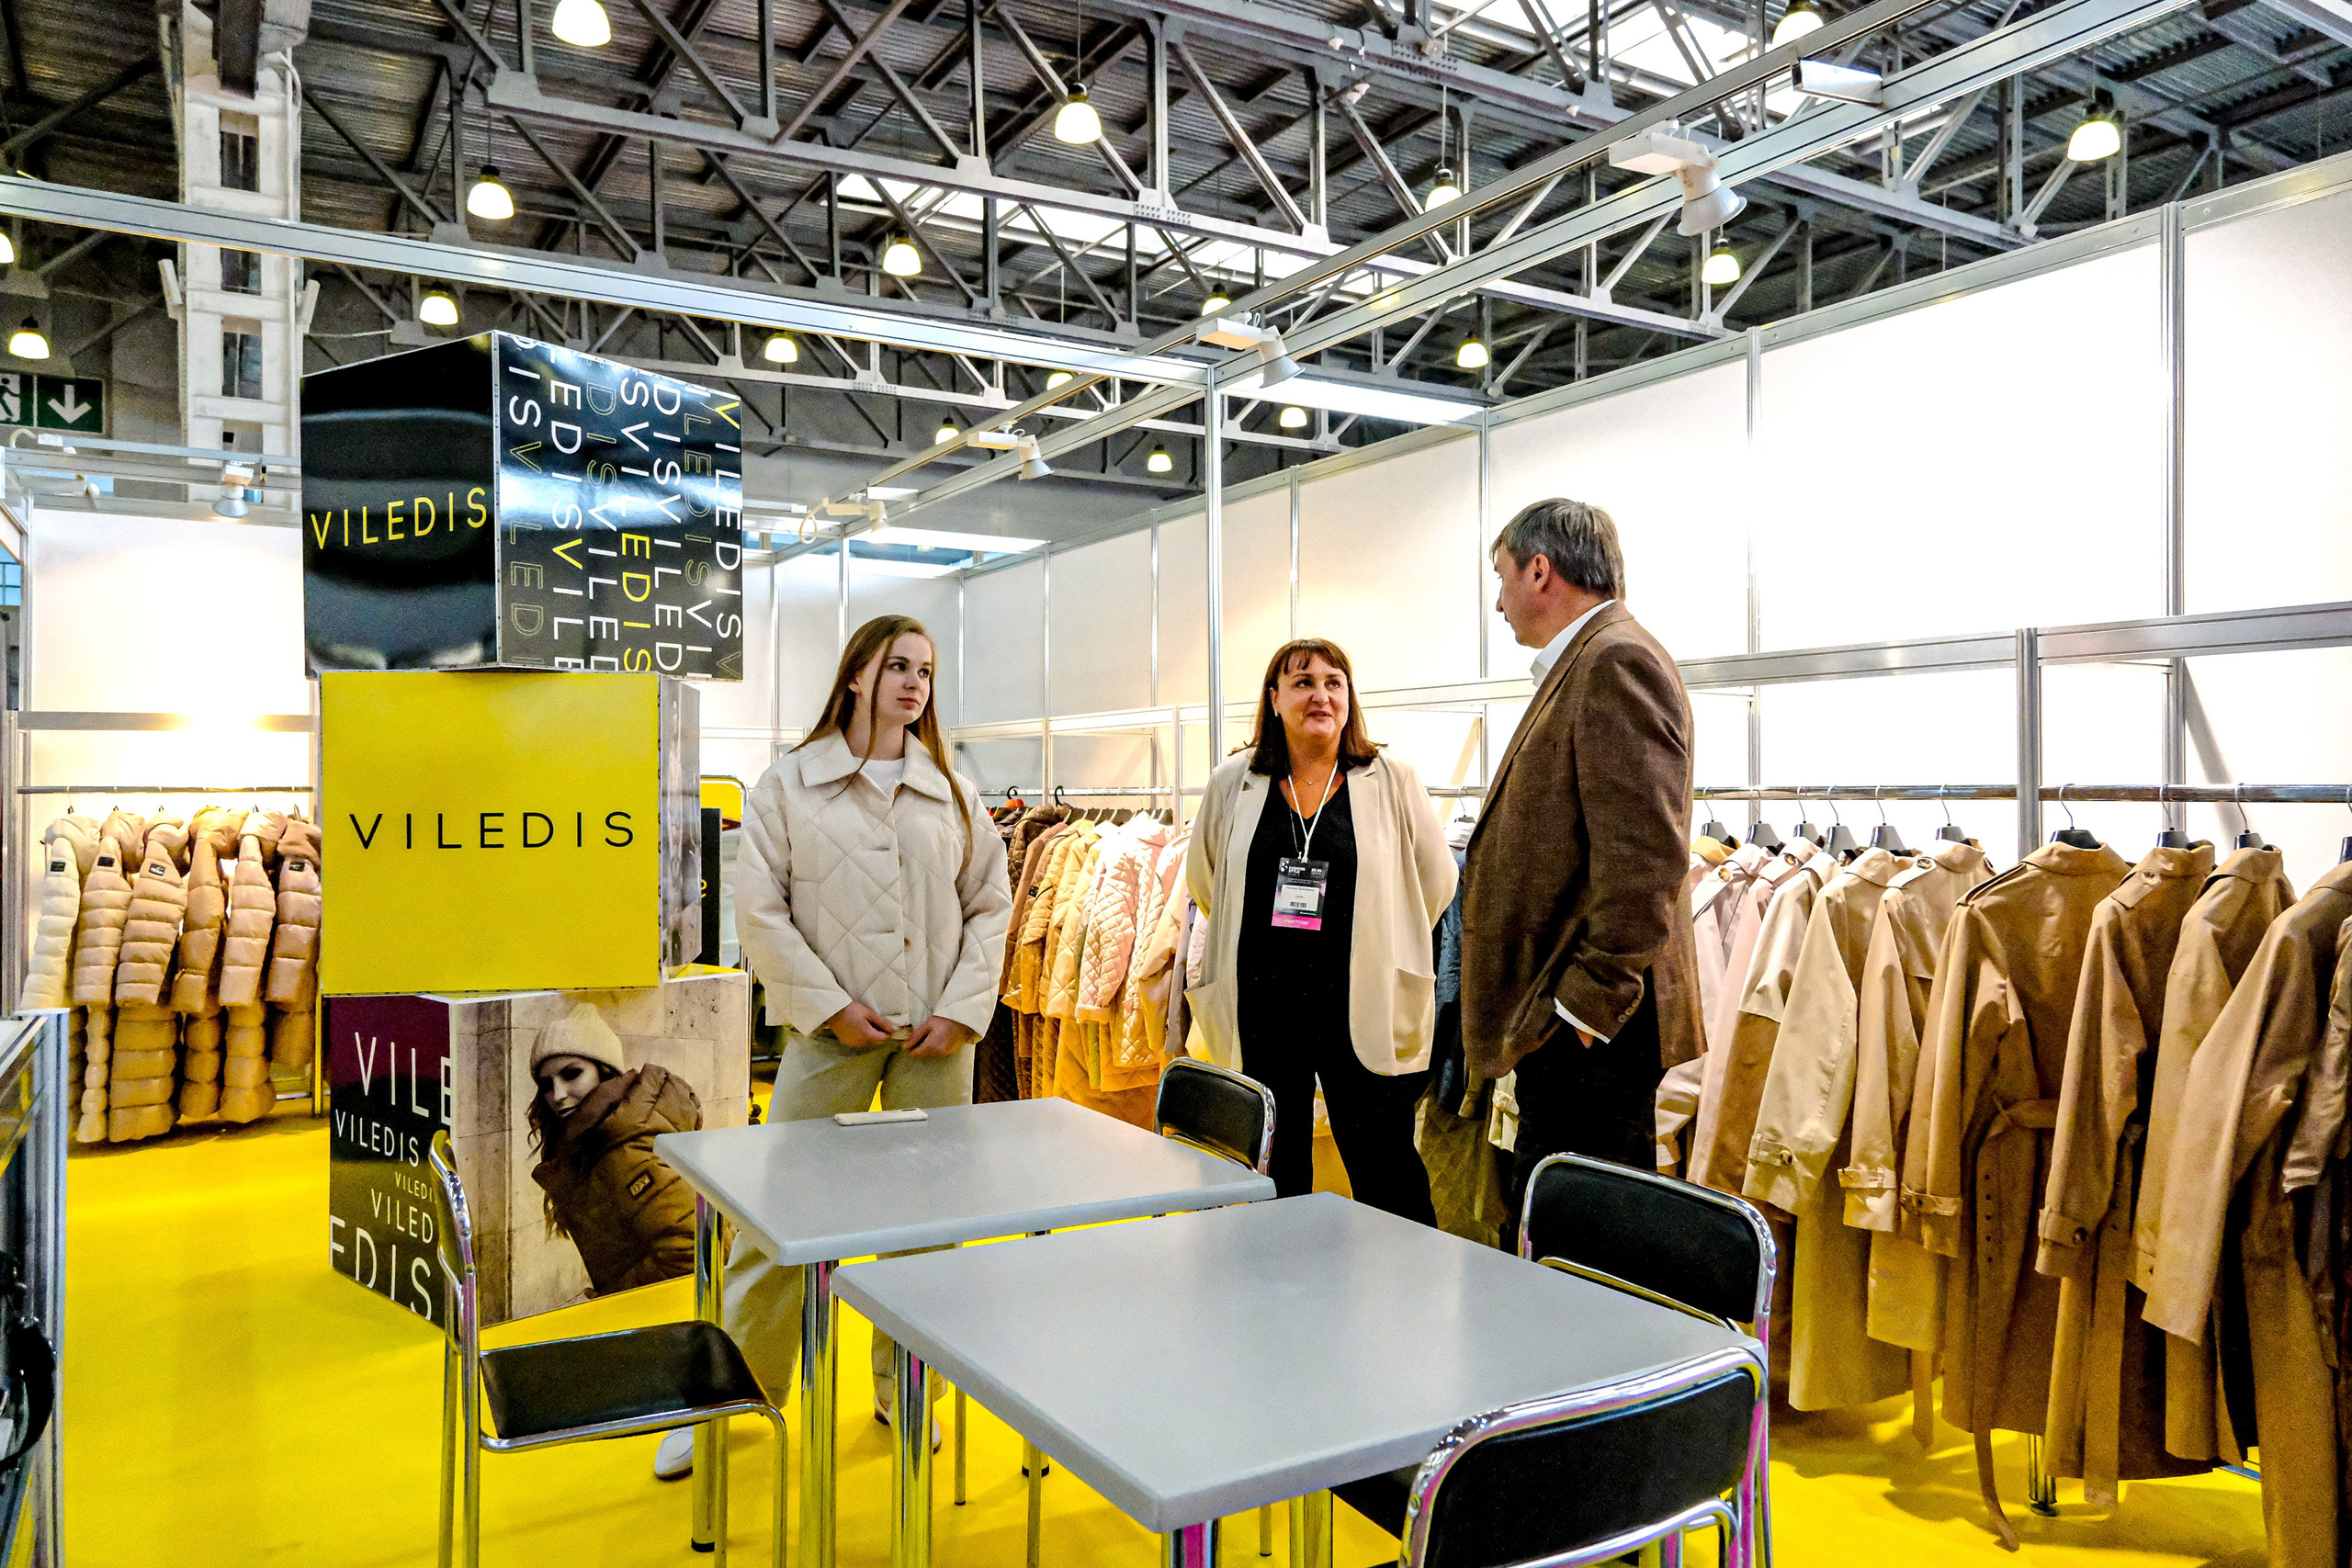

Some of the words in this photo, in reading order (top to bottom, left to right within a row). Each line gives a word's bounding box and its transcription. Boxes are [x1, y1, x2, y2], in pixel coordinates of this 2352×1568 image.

[311, 488, 488, 550] VILEDIS
[349, 811, 634, 850] VILEDIS
[335, 1109, 419, 1168] VILEDIS
[395, 1171, 436, 1204] VILEDI
[371, 1189, 434, 1244] VILED
